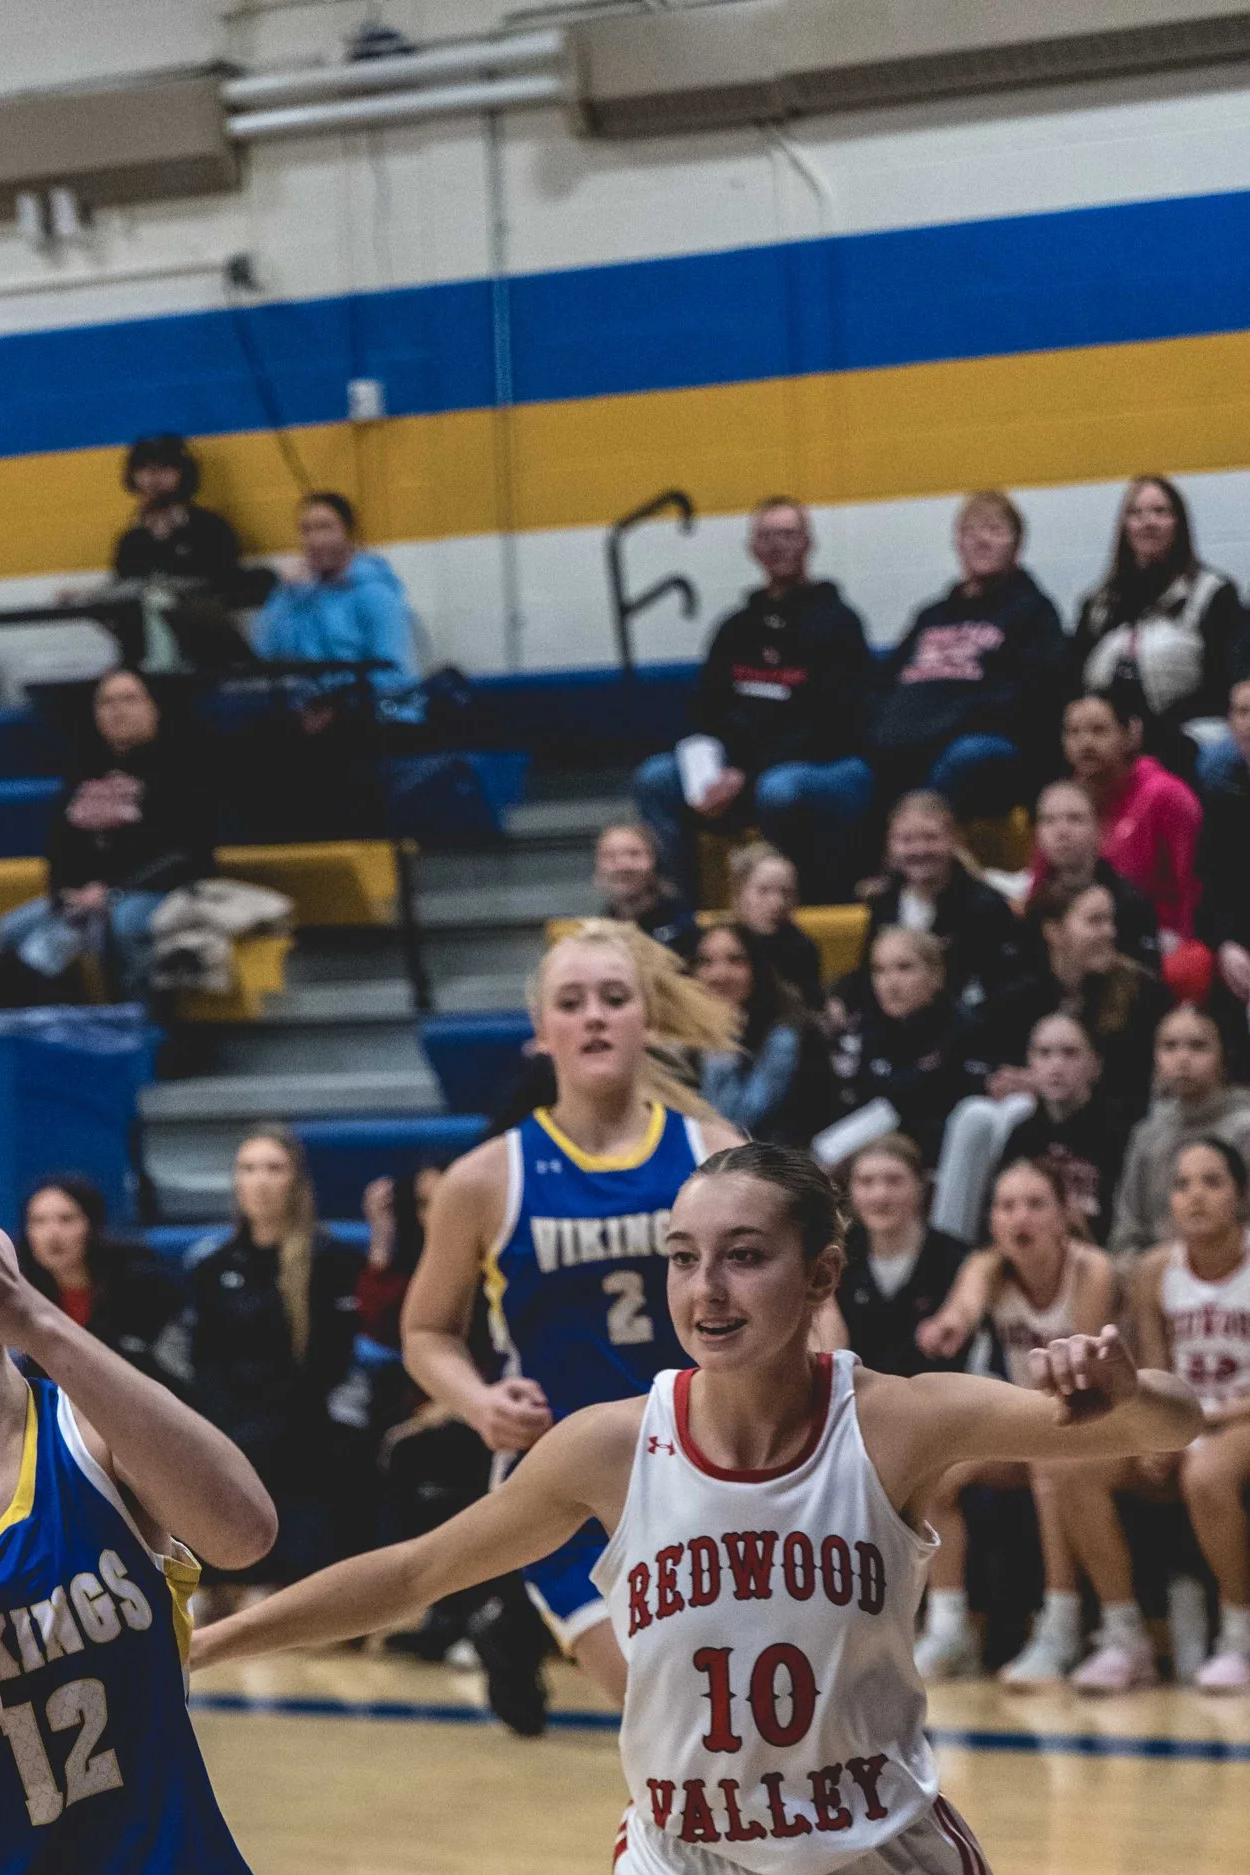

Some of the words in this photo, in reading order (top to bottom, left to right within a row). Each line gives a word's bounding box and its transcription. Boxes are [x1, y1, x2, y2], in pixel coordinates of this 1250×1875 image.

[529, 1208, 672, 1275] VIKING
[602, 1269, 654, 1345] 2
[628, 1530, 887, 1638] REDWOOD
[692, 1642, 822, 1754] 10
[0, 1677, 124, 1827] 12
[646, 1753, 889, 1843] VALLEY
